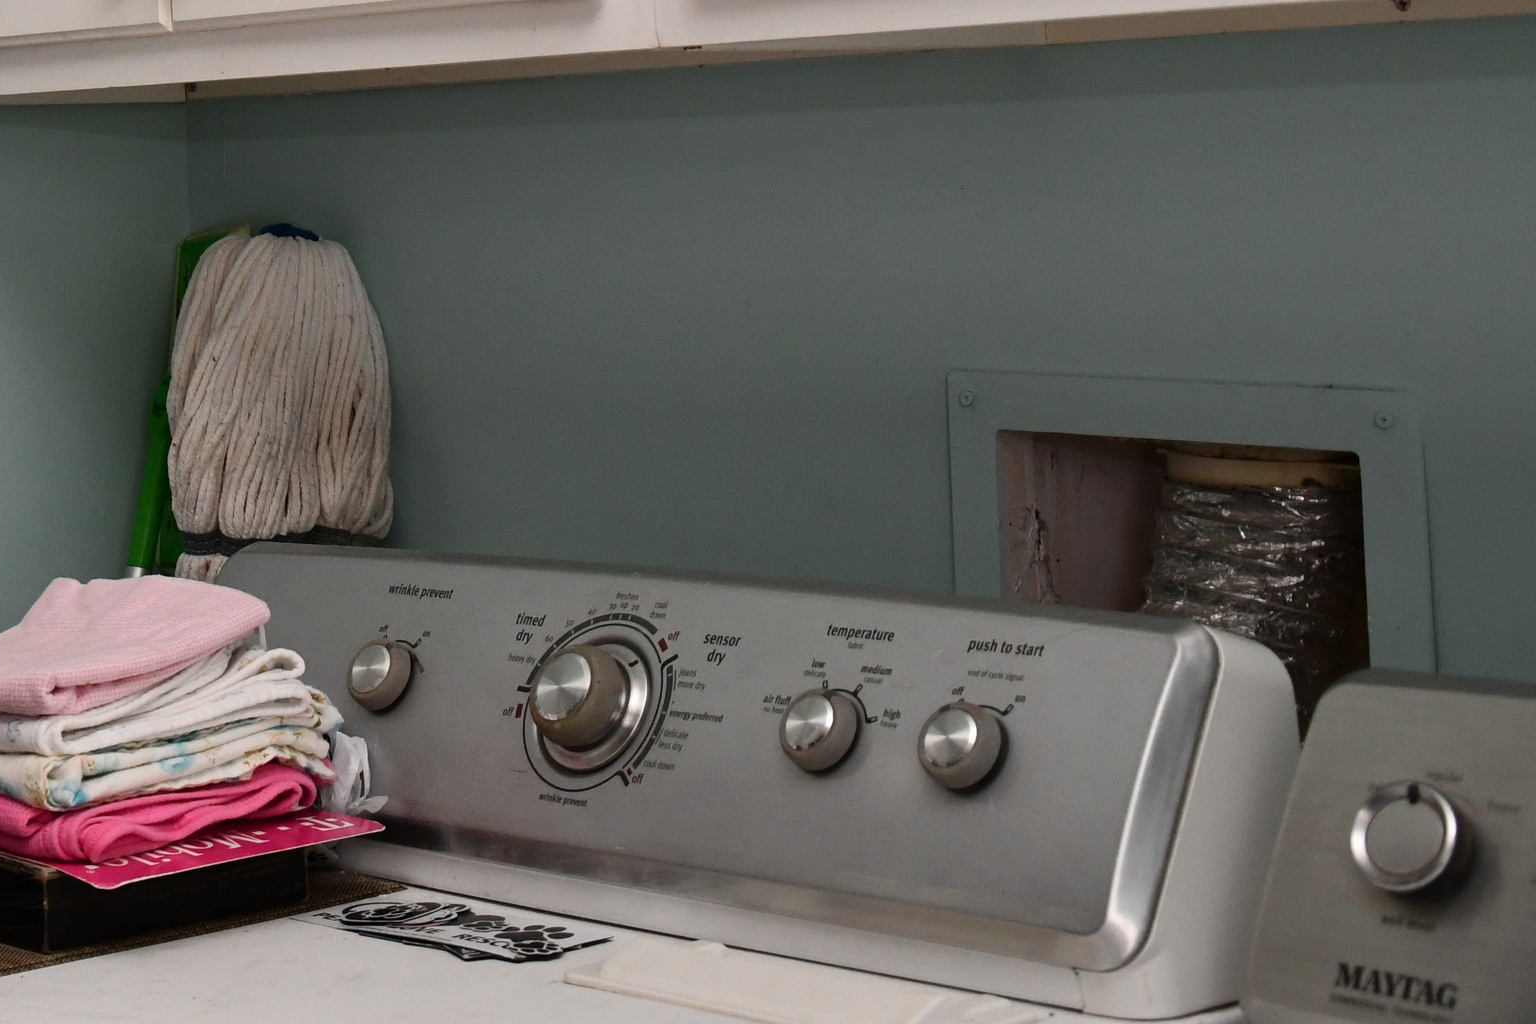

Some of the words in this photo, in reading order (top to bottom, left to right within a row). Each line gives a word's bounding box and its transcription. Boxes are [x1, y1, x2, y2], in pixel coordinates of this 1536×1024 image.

[388, 583, 420, 597] wrinkle
[420, 588, 454, 600] prevent
[616, 592, 640, 602] freshen
[608, 603, 617, 611] 30
[631, 604, 640, 612] 20
[654, 601, 668, 609] cool
[588, 608, 597, 616] 40
[649, 611, 666, 619] down
[516, 612, 546, 627] timed
[565, 620, 574, 628] 50
[379, 625, 389, 633] off
[422, 630, 431, 638] on
[826, 624, 895, 642] temperature
[516, 629, 533, 645] dry
[545, 635, 554, 643] 60
[668, 630, 681, 641] off
[703, 632, 742, 647] sensor
[967, 638, 998, 653] push
[1000, 641, 1013, 654] to
[1015, 643, 1045, 657] start
[508, 653, 525, 664] heavy
[525, 655, 537, 665] dry
[706, 649, 726, 666] dry
[811, 659, 826, 669] low
[677, 668, 697, 677] jeans
[861, 664, 893, 676] medium
[677, 680, 694, 689] more
[694, 681, 706, 691] dry
[952, 686, 965, 695] off
[763, 694, 774, 703] air
[774, 695, 793, 706] fluff
[503, 707, 515, 717] off
[669, 710, 691, 720] energy
[691, 712, 724, 723] preferred
[882, 708, 901, 721] high
[663, 729, 689, 740] delicate
[658, 740, 672, 750] less
[672, 742, 684, 752] dry
[643, 760, 658, 769] cool
[657, 761, 675, 770] down
[631, 774, 644, 784] off
[539, 792, 563, 804] wrinkle
[562, 796, 588, 807] prevent
[1335, 961, 1459, 1010] MAYTAG
